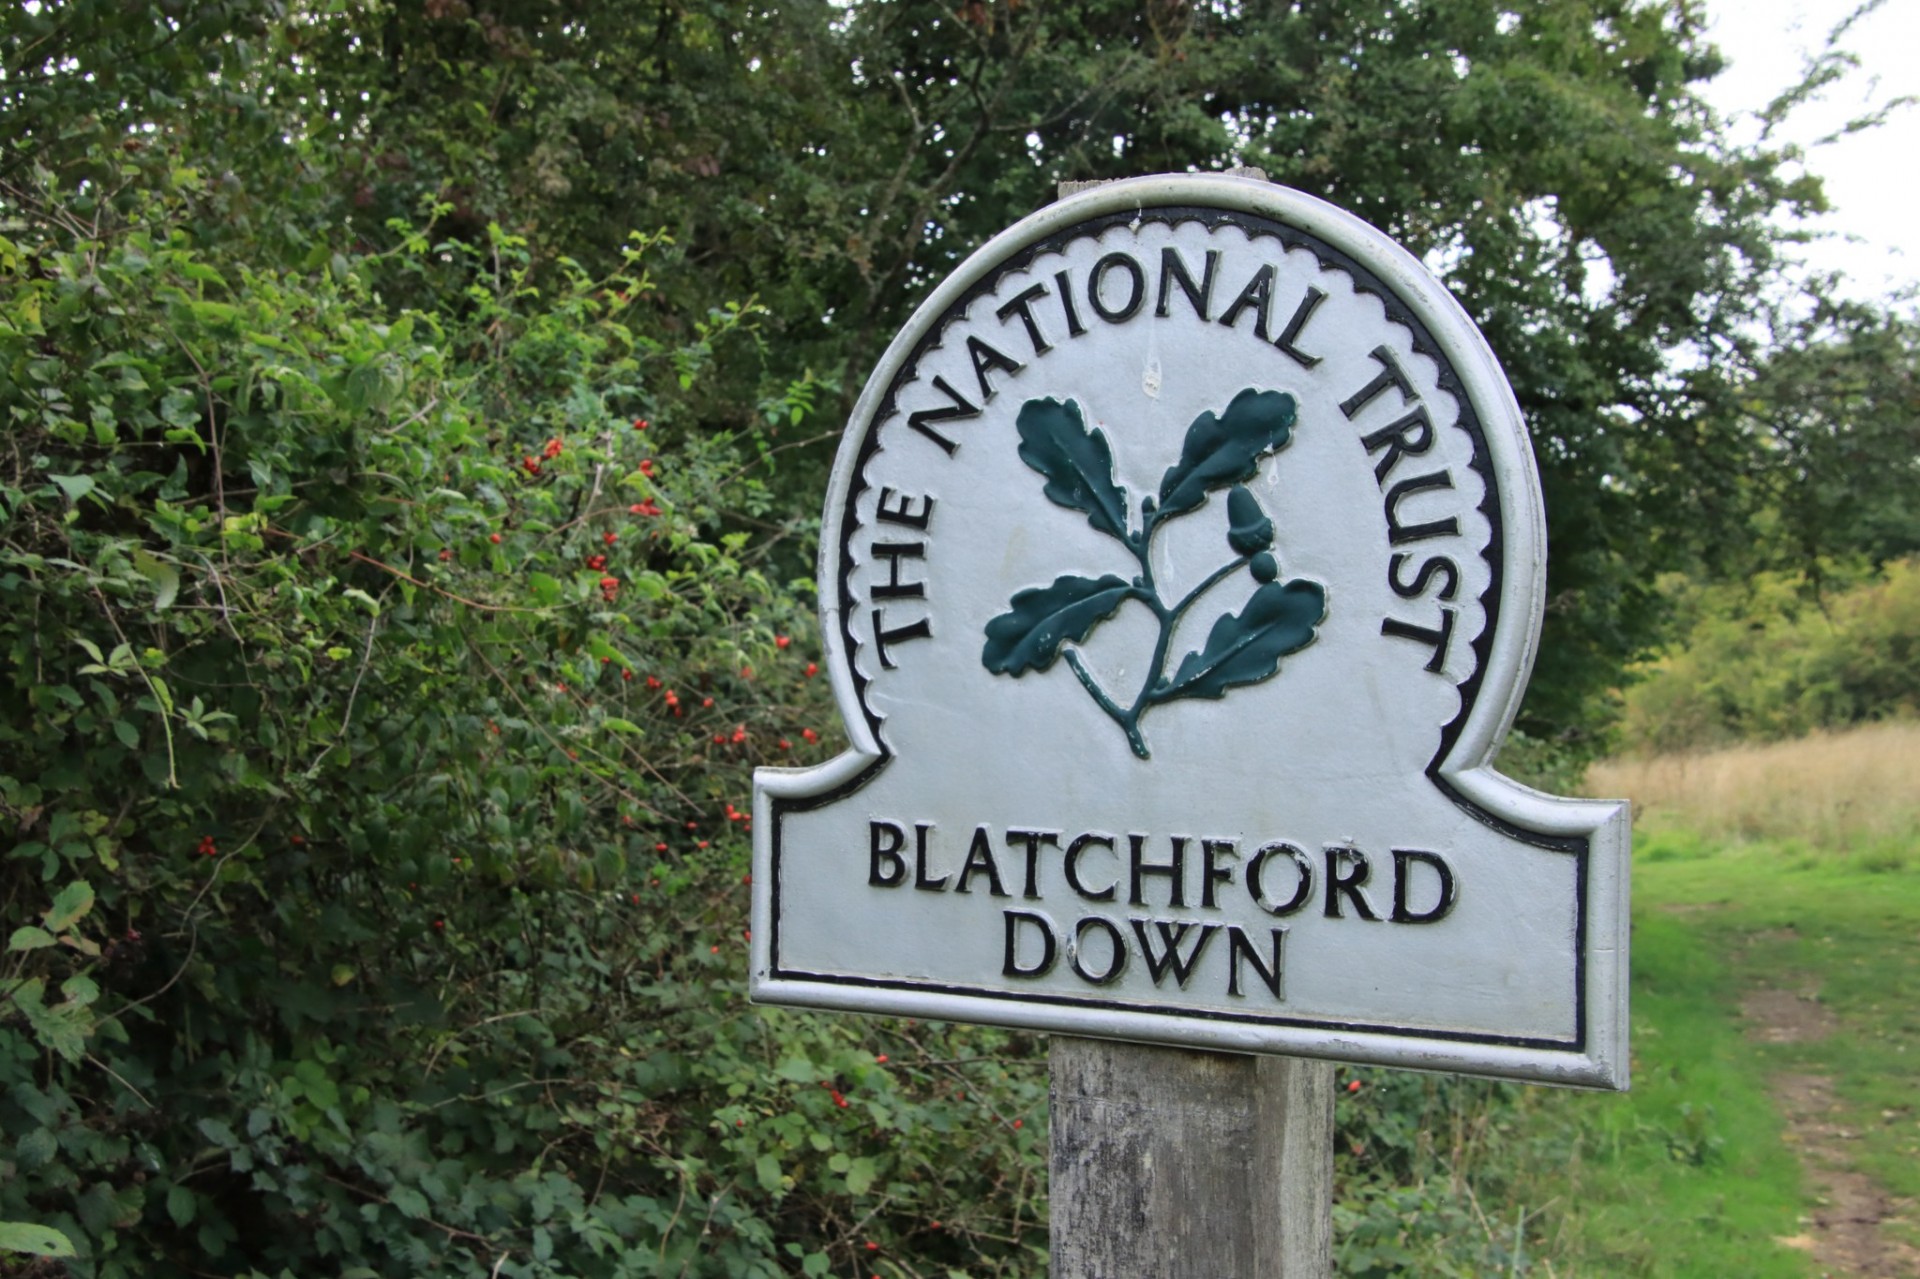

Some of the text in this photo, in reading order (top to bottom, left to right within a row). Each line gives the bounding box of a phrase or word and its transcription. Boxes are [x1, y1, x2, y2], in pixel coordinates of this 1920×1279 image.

[868, 247, 1461, 676] THE NATIONAL TRUST
[867, 820, 1458, 926] BLATCHFORD
[1001, 910, 1287, 1000] DOWN
